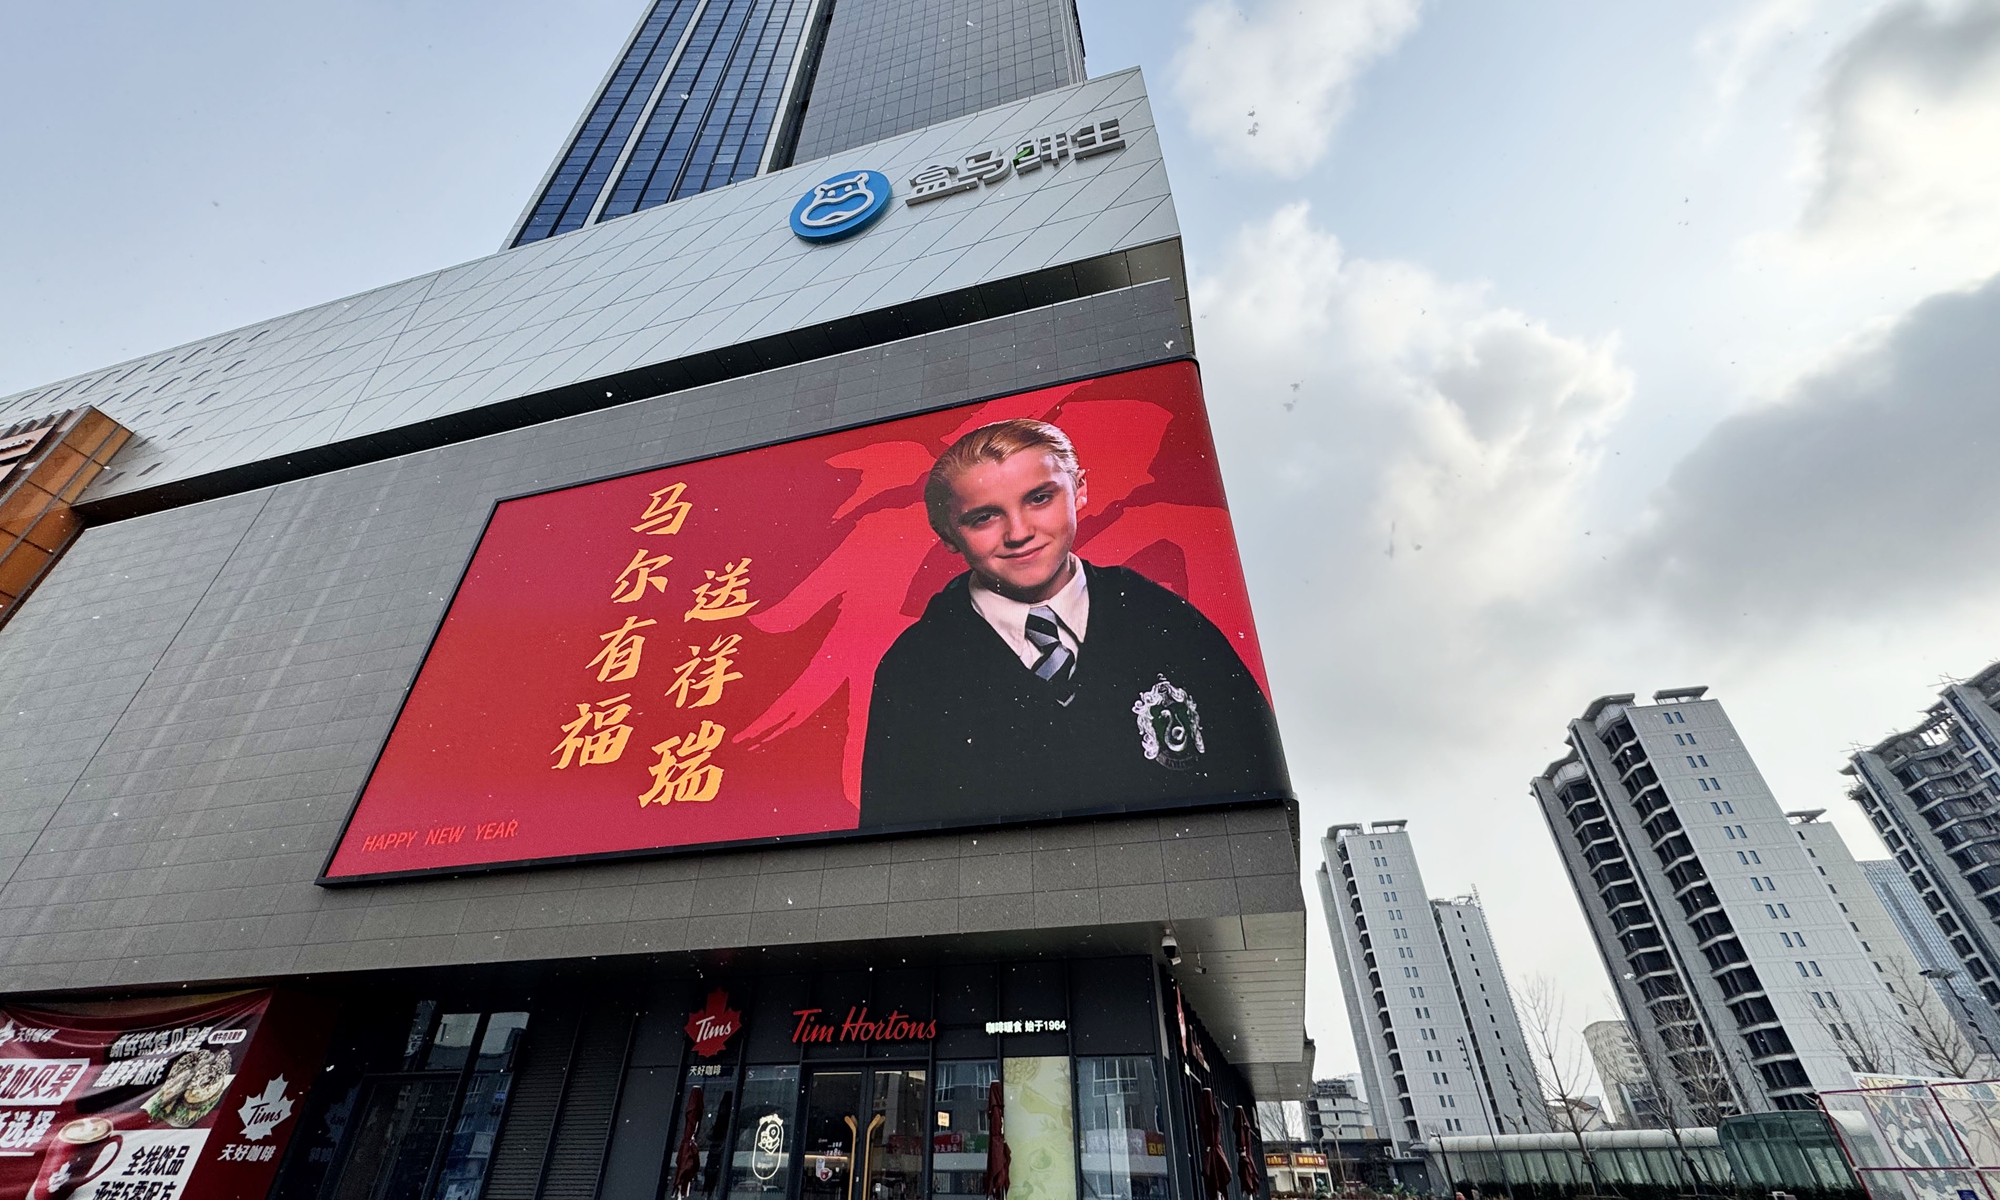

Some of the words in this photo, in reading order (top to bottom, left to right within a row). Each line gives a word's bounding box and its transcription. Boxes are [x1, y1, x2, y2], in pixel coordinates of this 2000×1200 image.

[905, 117, 1127, 206] 盒马鲜生
[550, 481, 693, 770] 马尔有福
[638, 557, 761, 809] 送祥瑞
[361, 830, 418, 852] HAPPY
[425, 825, 466, 846] NEW
[475, 819, 519, 842] YEAR
[695, 1015, 732, 1042] Tims
[792, 1009, 835, 1043] Tim
[839, 1006, 937, 1042] Hortons
[1024, 1020, 1067, 1033] 始于1964
[109, 1026, 214, 1058] 新鲜热烤贝果堡
[688, 1064, 722, 1077] 天好咖啡
[247, 1102, 283, 1126] Tims
[122, 1145, 190, 1176] 全线饮品
[217, 1143, 277, 1162] 天好咖啡
